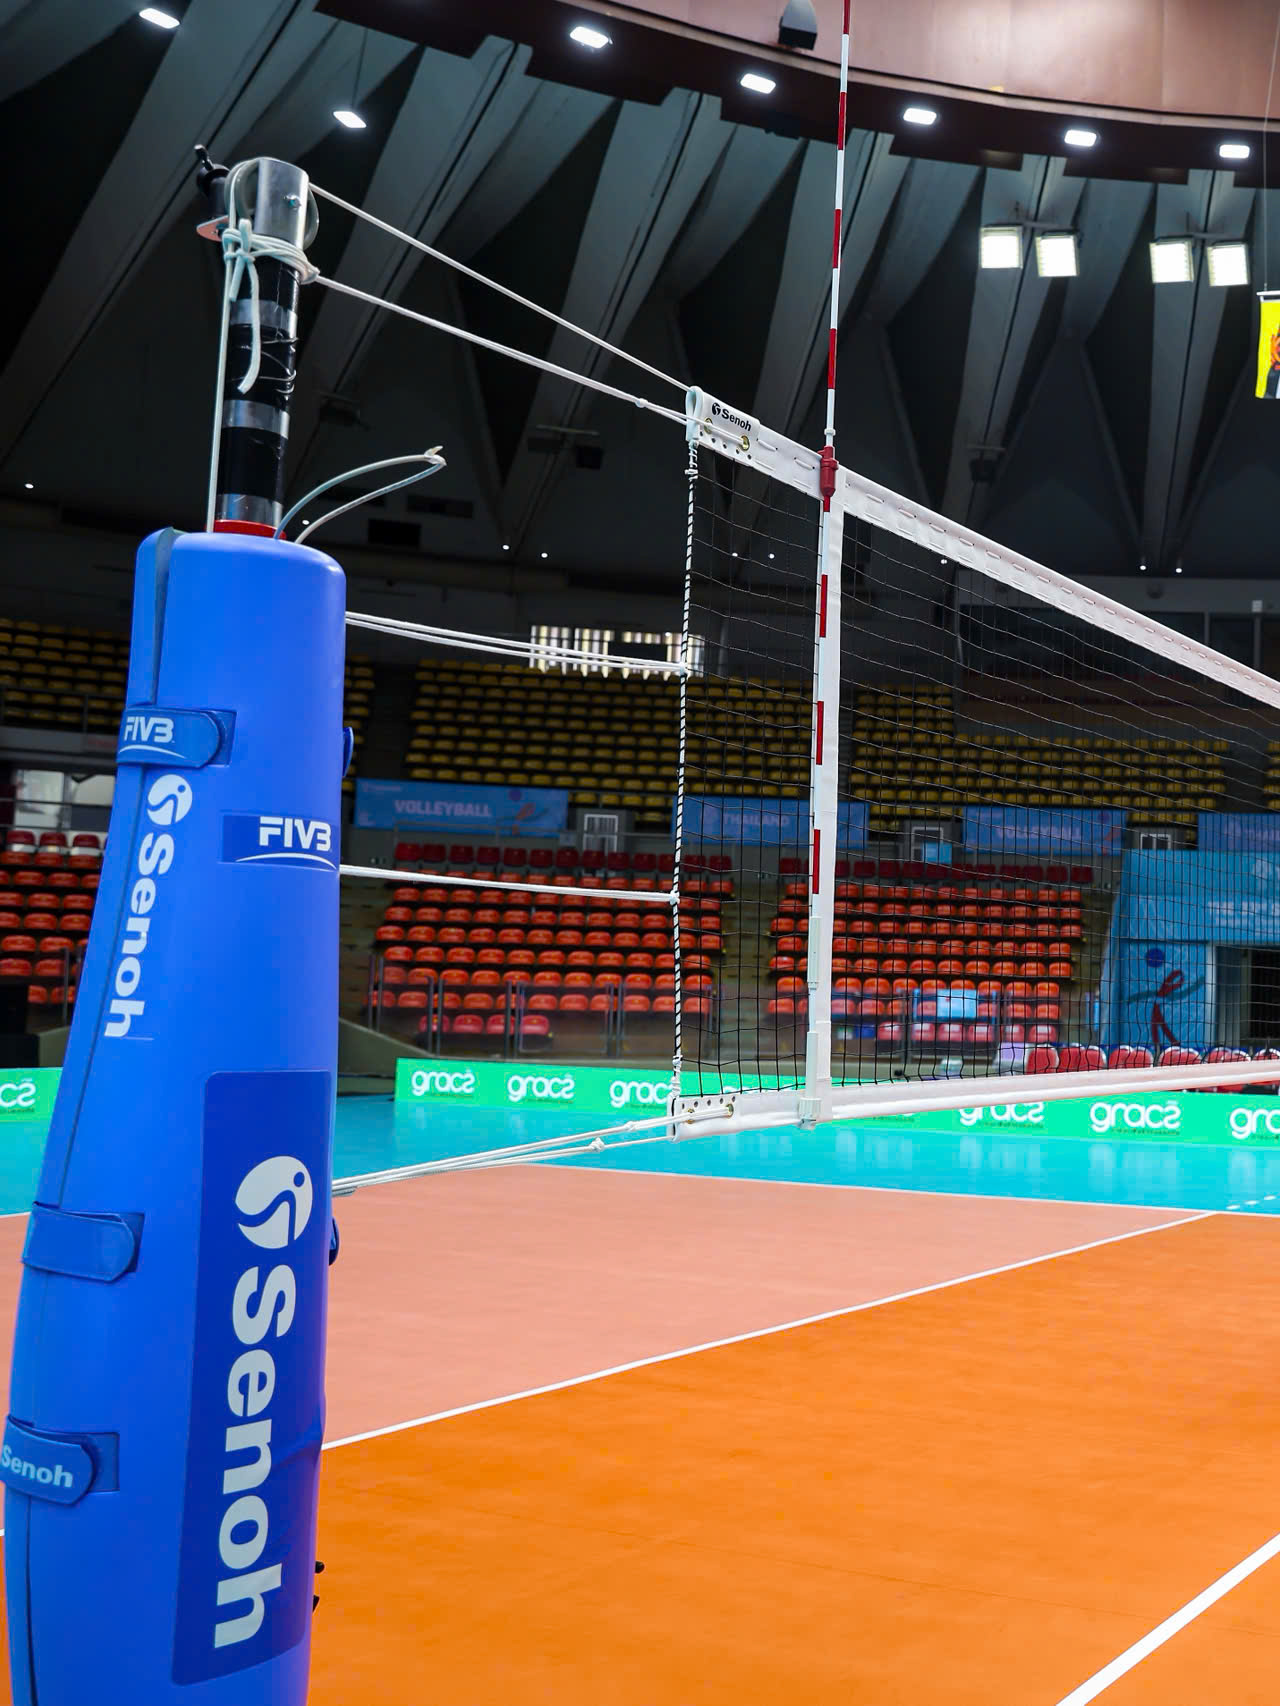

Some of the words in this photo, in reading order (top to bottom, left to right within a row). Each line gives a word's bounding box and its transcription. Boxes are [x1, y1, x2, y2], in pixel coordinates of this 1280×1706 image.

[721, 408, 752, 431] Senoh
[124, 716, 174, 743] FIVB
[394, 799, 491, 818] VOLLEYBALL
[258, 816, 332, 851] FIVB
[103, 832, 175, 1038] Senoh
[609, 1080, 672, 1108] grac
[1, 1444, 74, 1488] Senoh
[213, 1264, 297, 1650] Senoh
